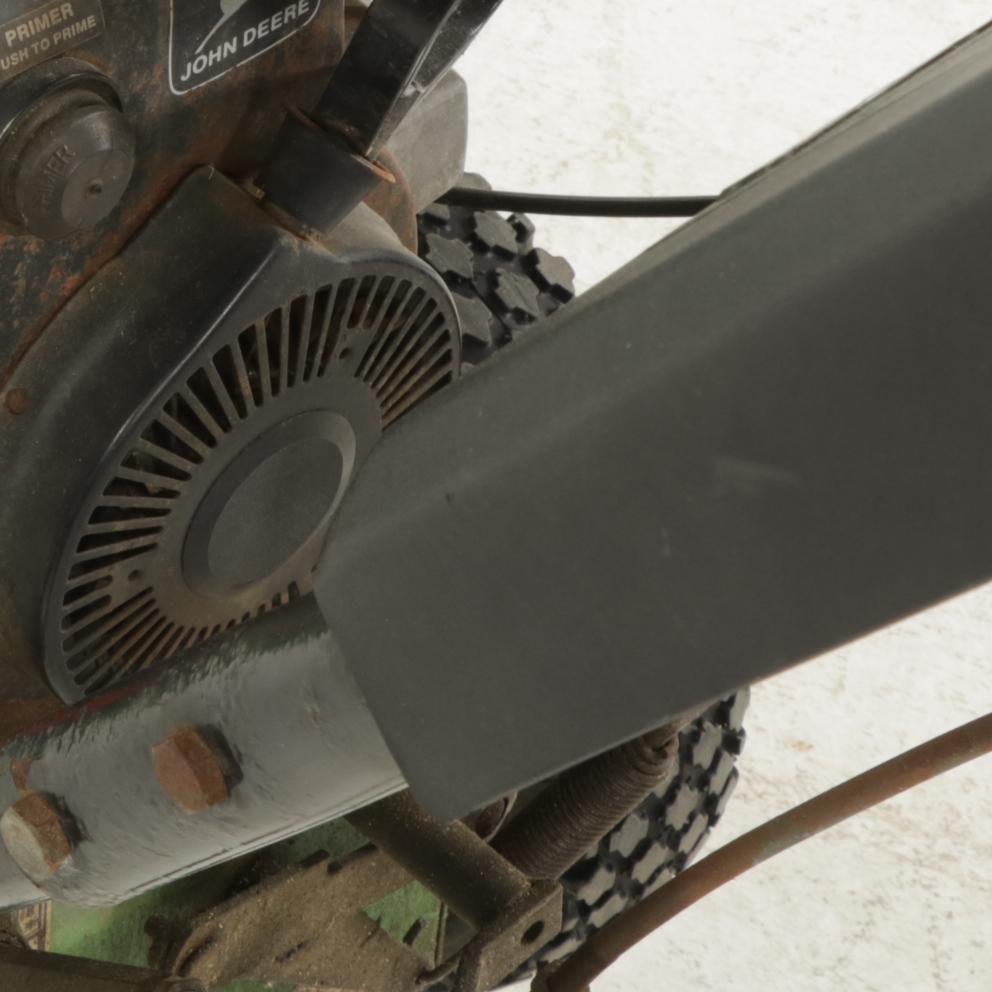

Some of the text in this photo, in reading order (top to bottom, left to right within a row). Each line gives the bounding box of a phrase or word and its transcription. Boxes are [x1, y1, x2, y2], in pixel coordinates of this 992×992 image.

[5, 2, 74, 46] PRIMER
[31, 37, 50, 54] TO
[53, 15, 96, 45] PRIME
[181, 37, 237, 81] JOHN
